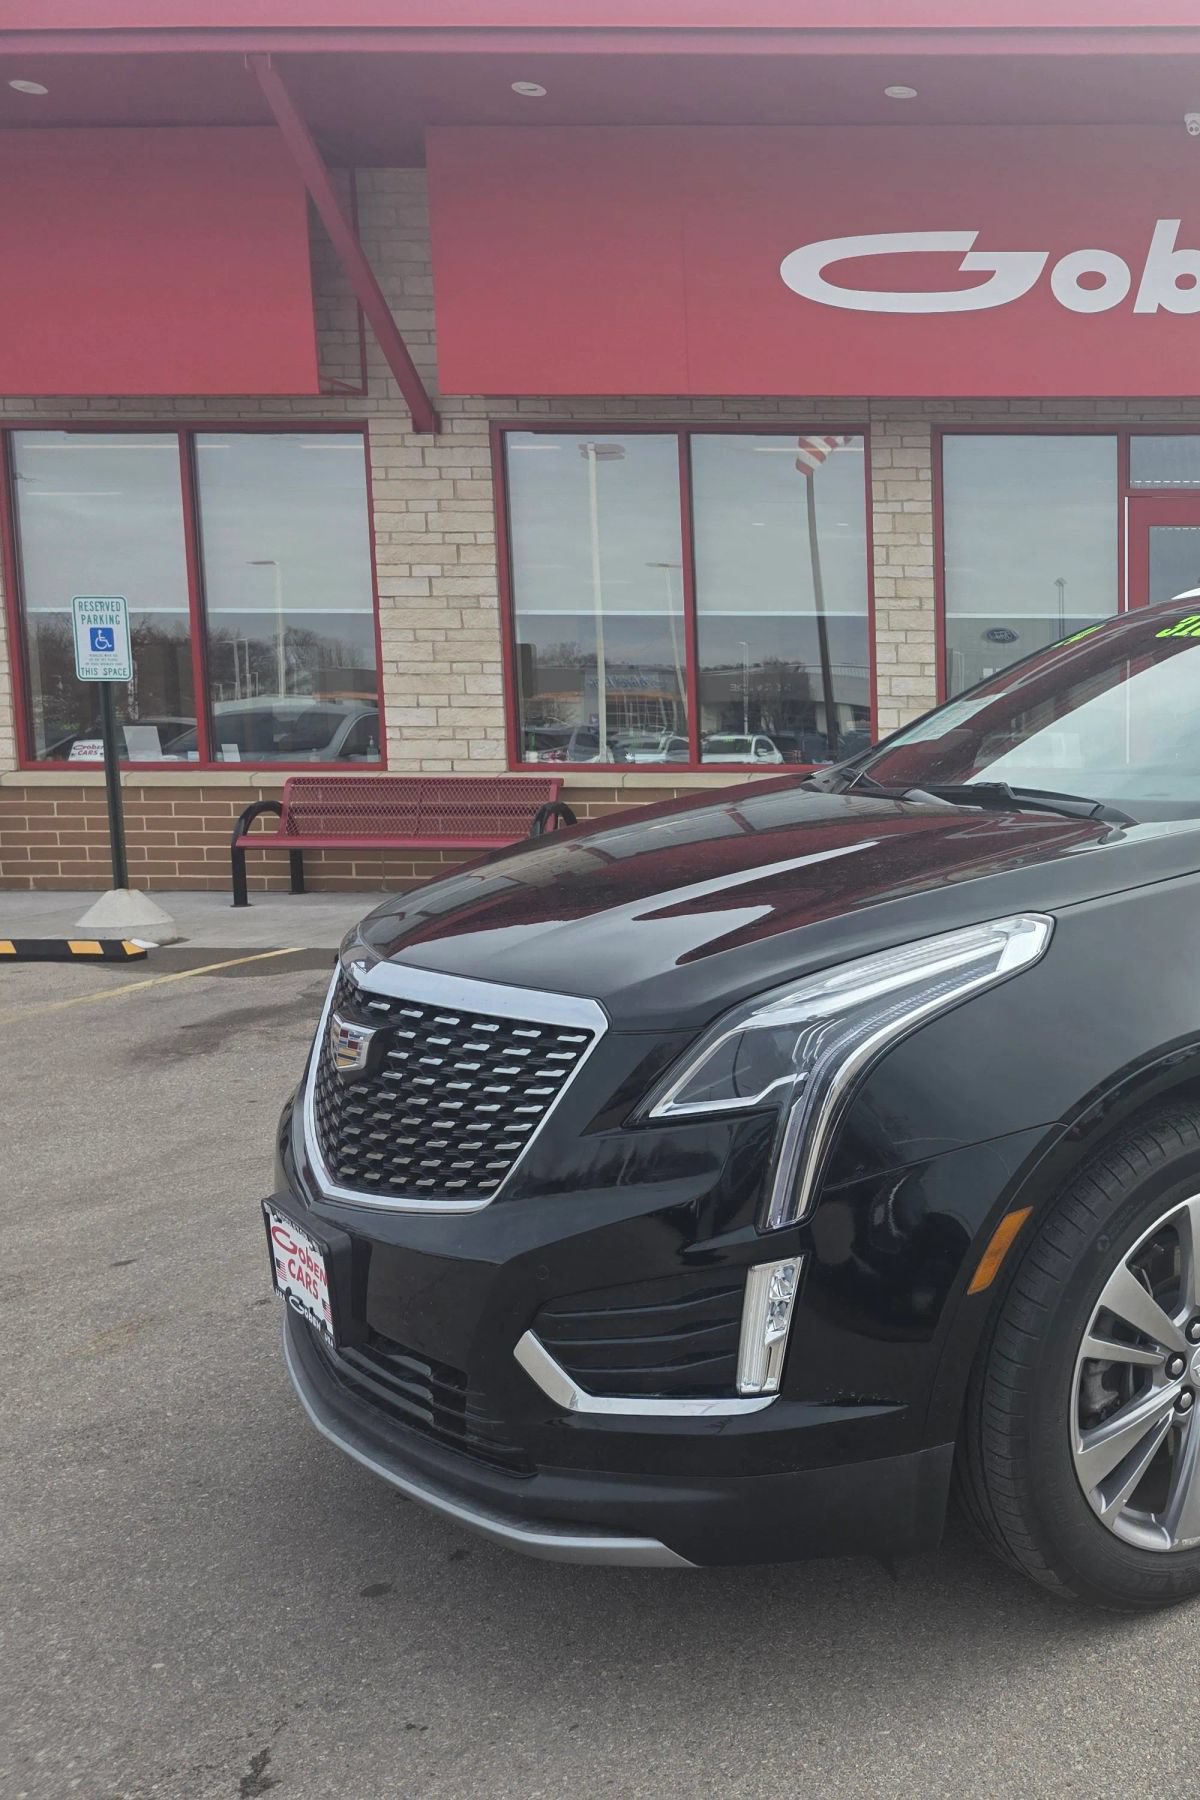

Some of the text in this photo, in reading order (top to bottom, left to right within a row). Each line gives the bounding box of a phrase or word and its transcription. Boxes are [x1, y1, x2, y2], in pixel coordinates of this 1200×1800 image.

[78, 600, 121, 612] RESERVED
[80, 614, 121, 625] PARKING
[80, 667, 128, 677] THIS SPACE
[287, 1258, 319, 1301] CARS
